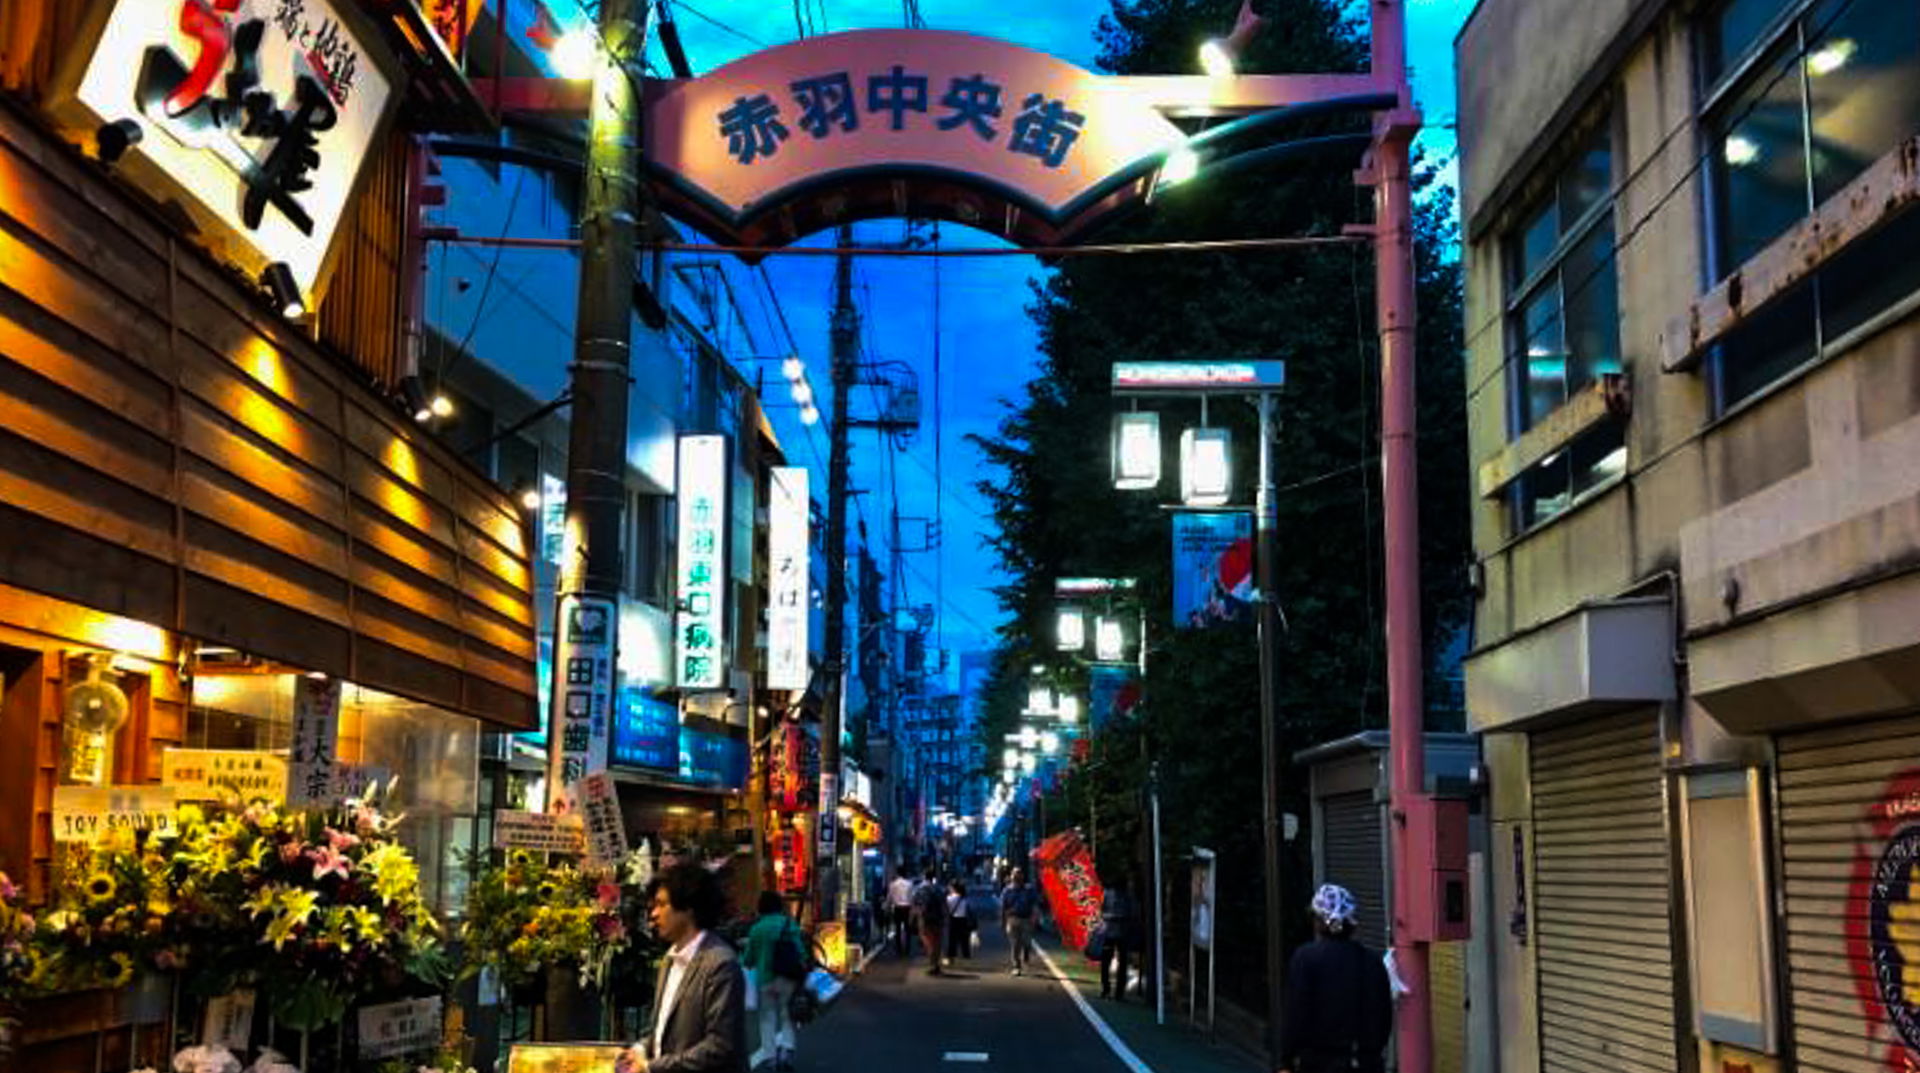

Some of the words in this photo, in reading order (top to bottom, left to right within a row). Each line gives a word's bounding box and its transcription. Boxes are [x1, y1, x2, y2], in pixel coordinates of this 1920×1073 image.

[718, 66, 1086, 168] 赤羽中央街
